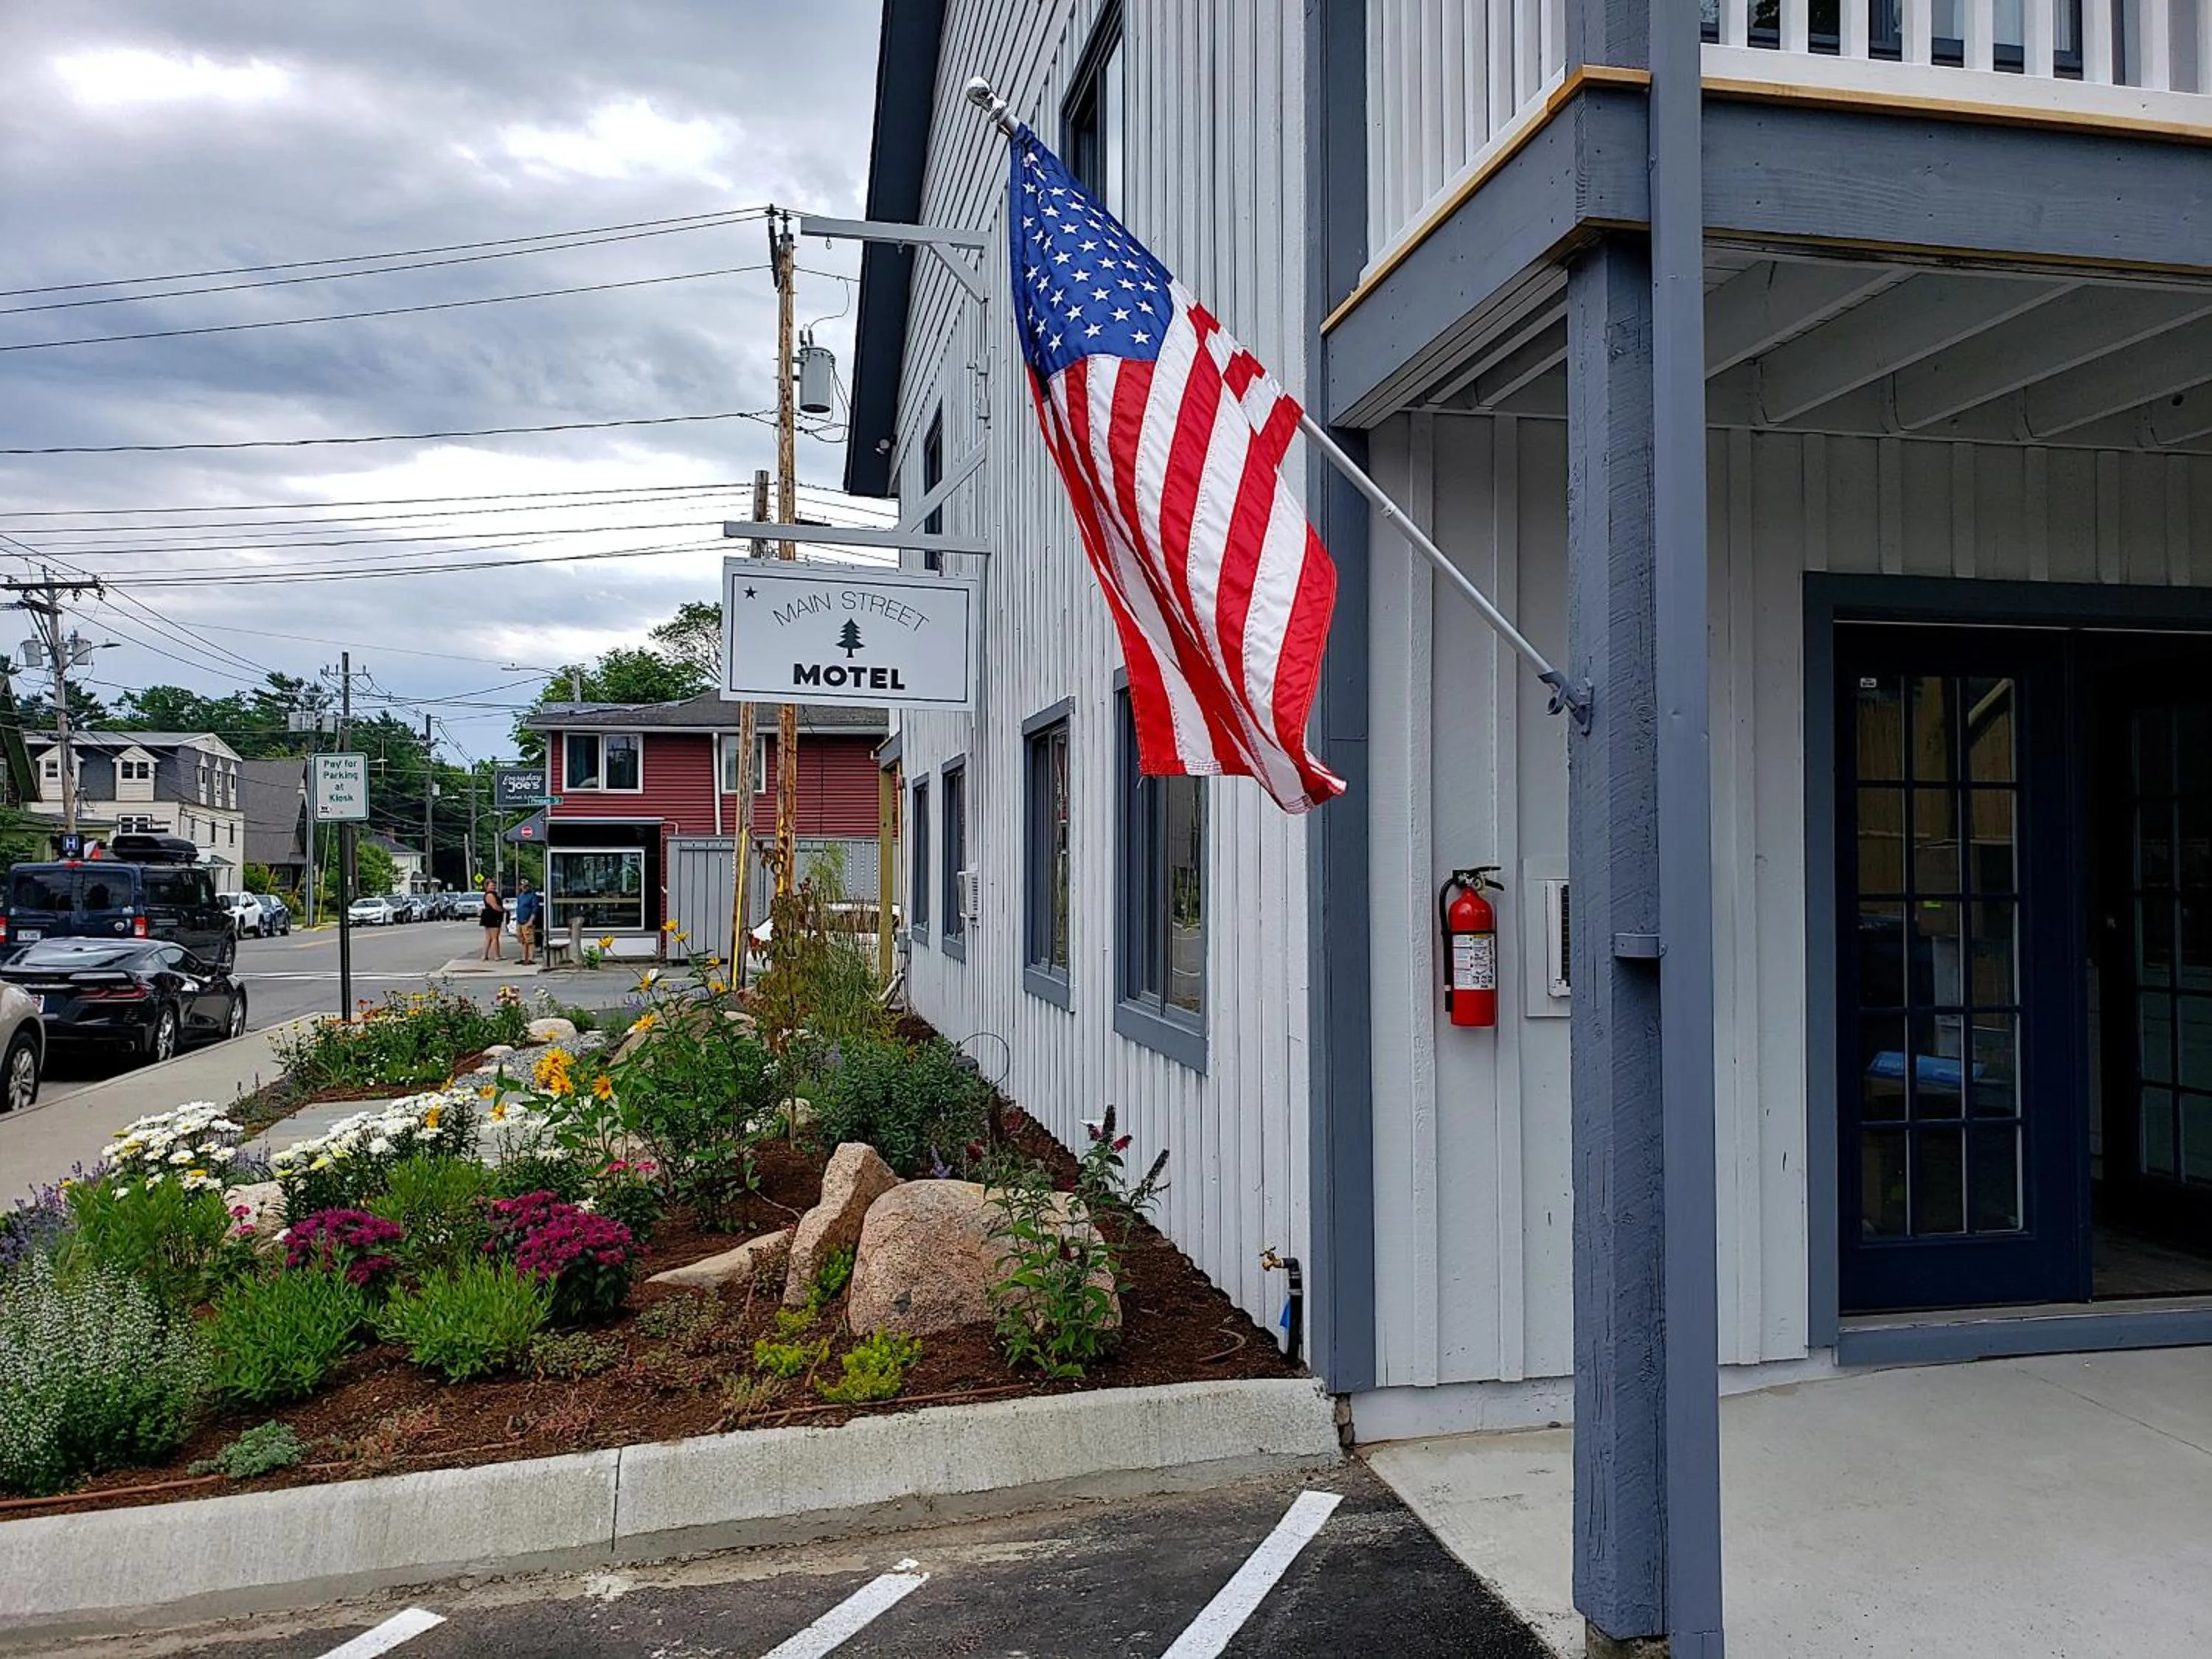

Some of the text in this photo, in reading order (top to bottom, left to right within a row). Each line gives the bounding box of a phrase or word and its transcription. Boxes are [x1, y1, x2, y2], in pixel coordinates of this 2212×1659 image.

[772, 591, 930, 631] MAIN STREET
[793, 664, 905, 690] MOTEL
[324, 759, 358, 768] Pay for
[324, 771, 358, 782] Parking
[330, 794, 354, 802] Kiosk
[66, 838, 76, 849] H
